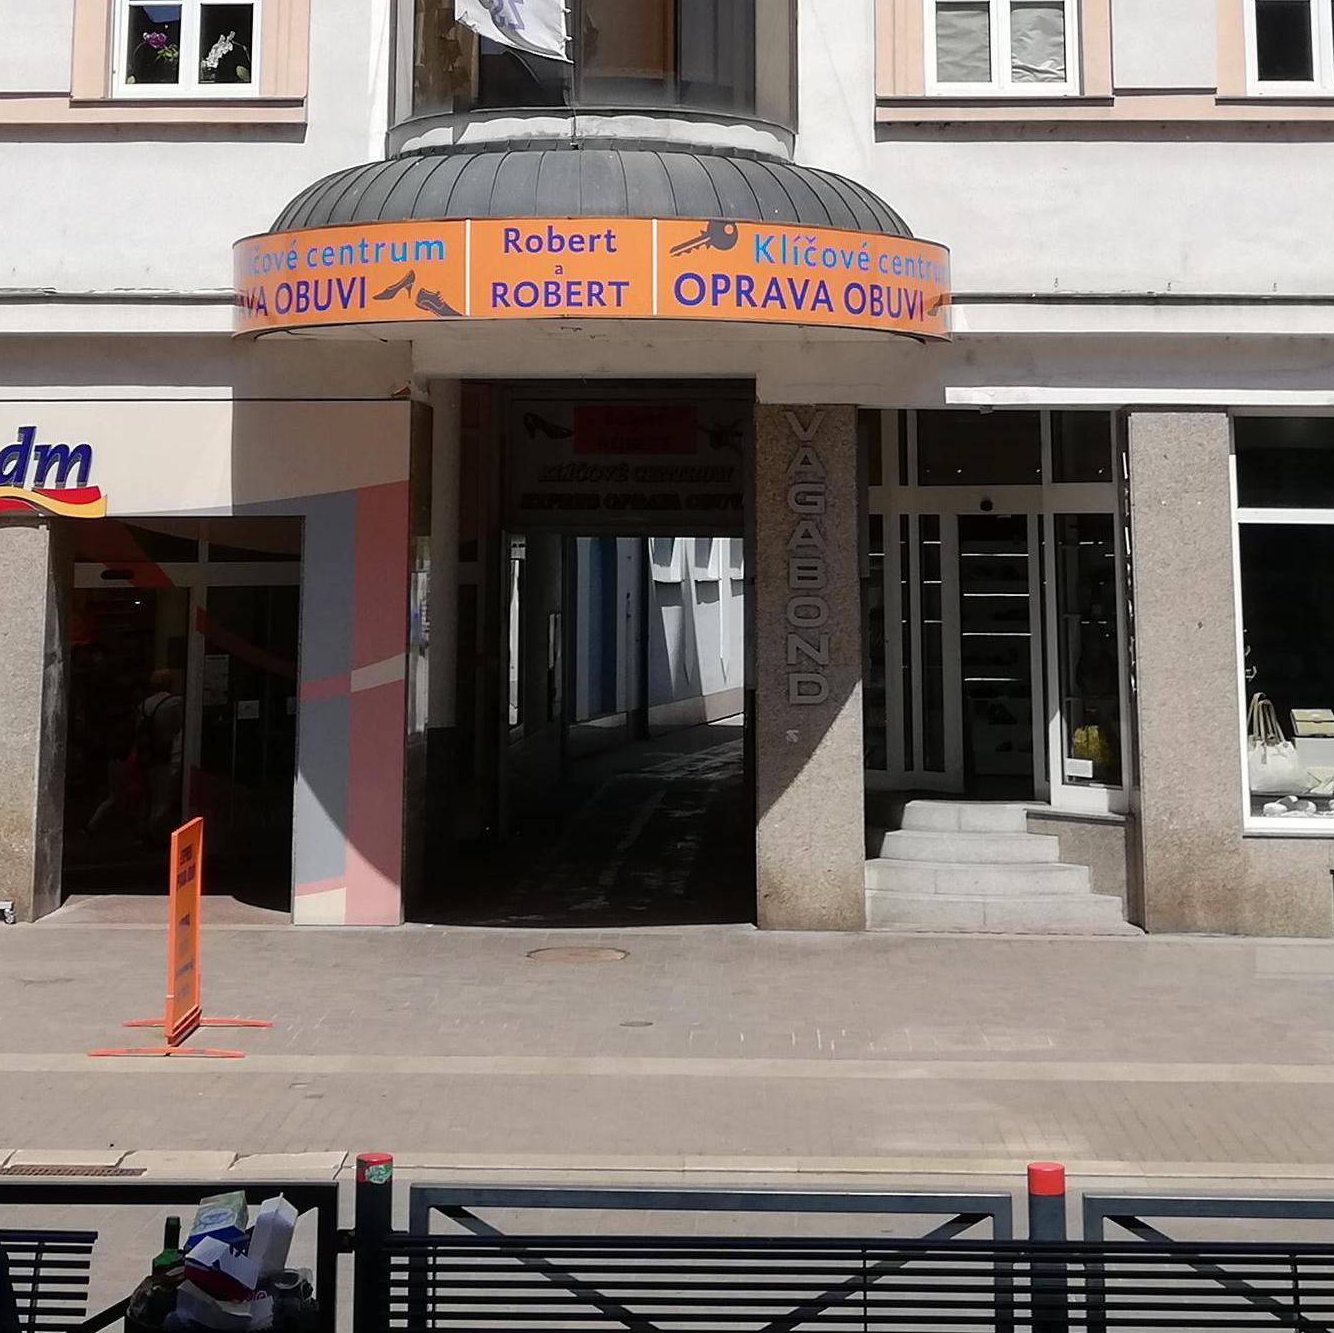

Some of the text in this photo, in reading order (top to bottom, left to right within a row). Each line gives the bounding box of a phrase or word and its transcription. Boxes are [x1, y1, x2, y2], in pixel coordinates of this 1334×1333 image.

[306, 238, 444, 267] centrum
[503, 225, 617, 254] Robert
[754, 233, 870, 271] Klíčové
[555, 265, 564, 275] a
[275, 276, 366, 315] OBUVI
[491, 280, 630, 308] ROBERT
[674, 272, 924, 323] OPRAVA OBUVI
[786, 411, 829, 705] VAGABOND
